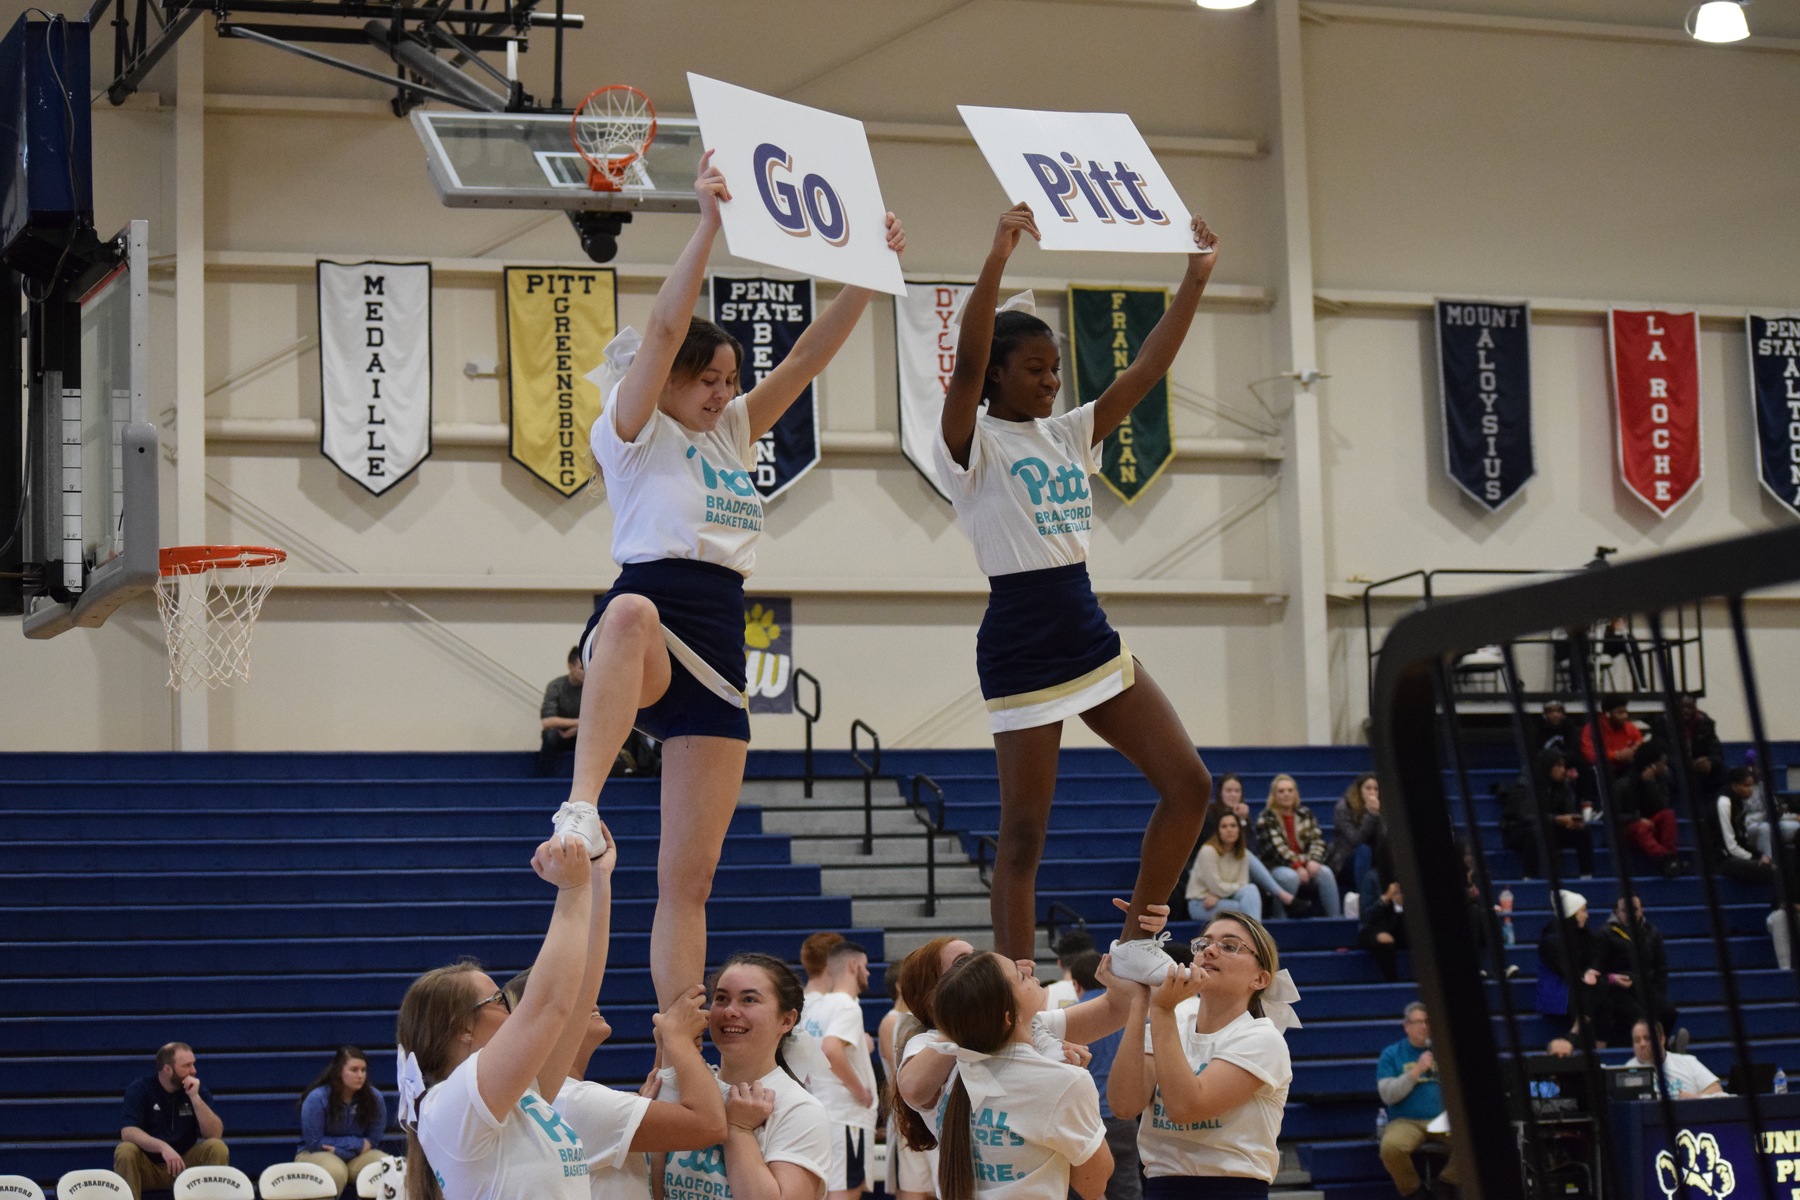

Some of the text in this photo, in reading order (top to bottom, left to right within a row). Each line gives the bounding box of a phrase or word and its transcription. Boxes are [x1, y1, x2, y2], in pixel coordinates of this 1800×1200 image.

[753, 142, 850, 248] Go
[1022, 150, 1172, 226] Pitt
[526, 274, 596, 294] PITT
[730, 281, 795, 301] PENN
[721, 303, 803, 322] STATE
[1446, 305, 1520, 327] MOUNT
[364, 275, 386, 477] MEDAILLE
[553, 297, 576, 487] GREENSBURG
[1476, 328, 1502, 500] ALOYSIUS
[1647, 315, 1671, 501] LA ROCHE
[1010, 457, 1089, 505] Pitt
[69, 1180, 120, 1195] PITT-BRADFORD
[186, 1176, 241, 1191] PITT-BRADFORD
[271, 1173, 324, 1188] PITT-BRADFORD
